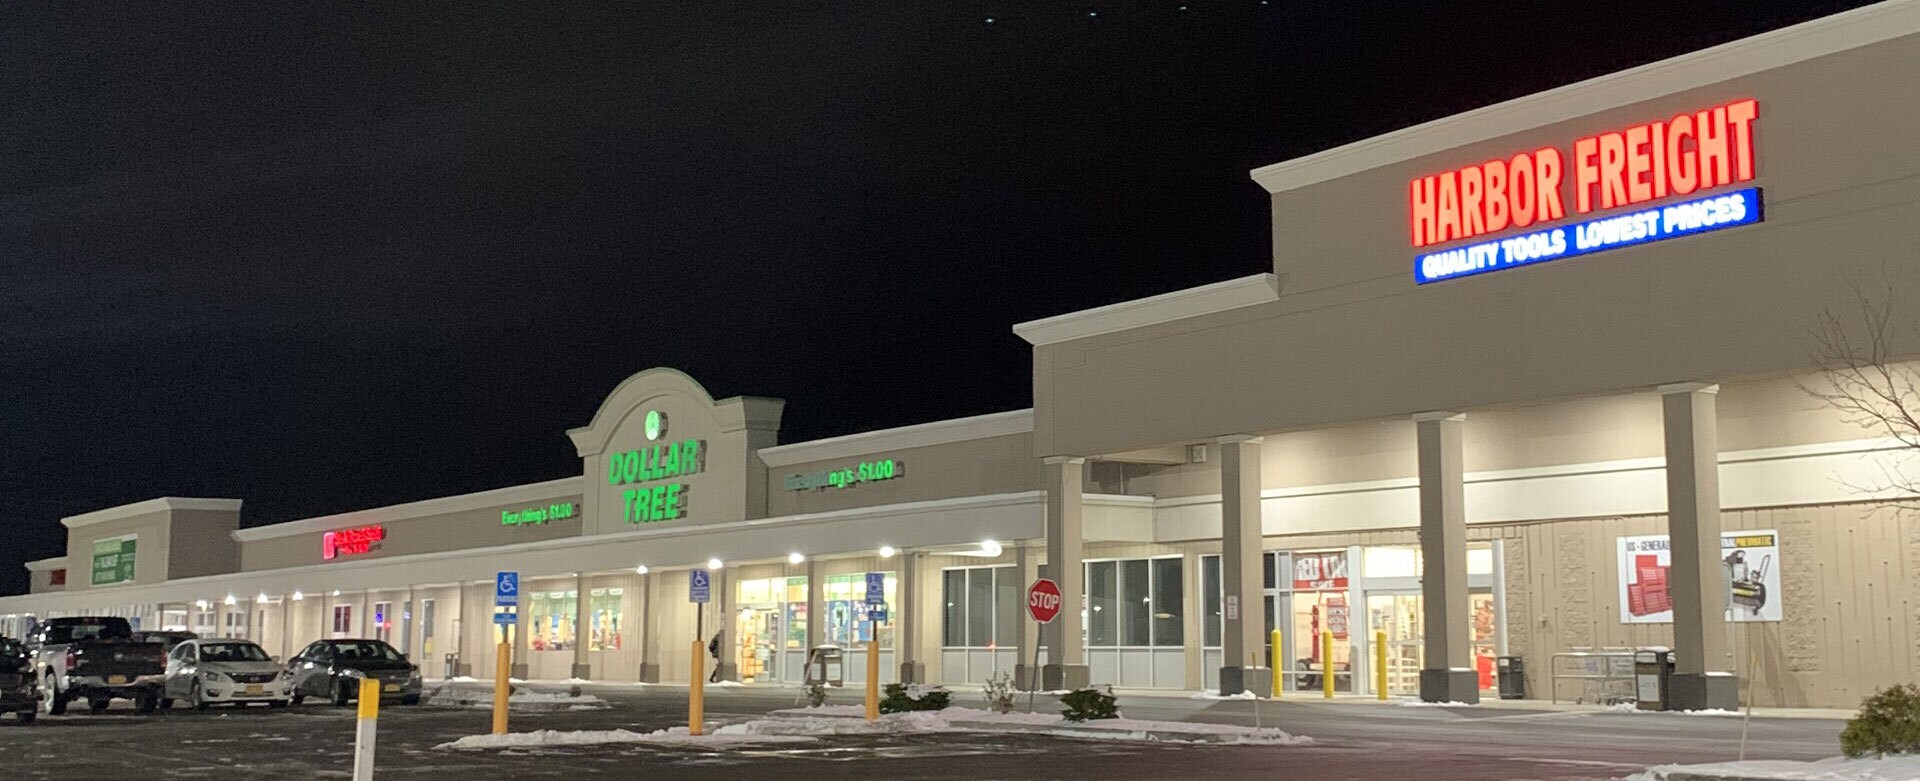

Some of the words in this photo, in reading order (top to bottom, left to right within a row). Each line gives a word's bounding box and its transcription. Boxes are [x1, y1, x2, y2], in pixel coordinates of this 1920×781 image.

[1410, 147, 1563, 246] HARBOR
[1574, 99, 1759, 213] FREIGHT
[1422, 242, 1499, 279] QUALITY
[1502, 230, 1567, 264] TOOLS
[1576, 210, 1660, 250] LOWEST
[1663, 194, 1746, 234] PRICES
[607, 438, 699, 485] DOLLAR
[858, 459, 895, 481] $1.00
[622, 483, 681, 525] TREE
[1030, 591, 1059, 610] STOP
